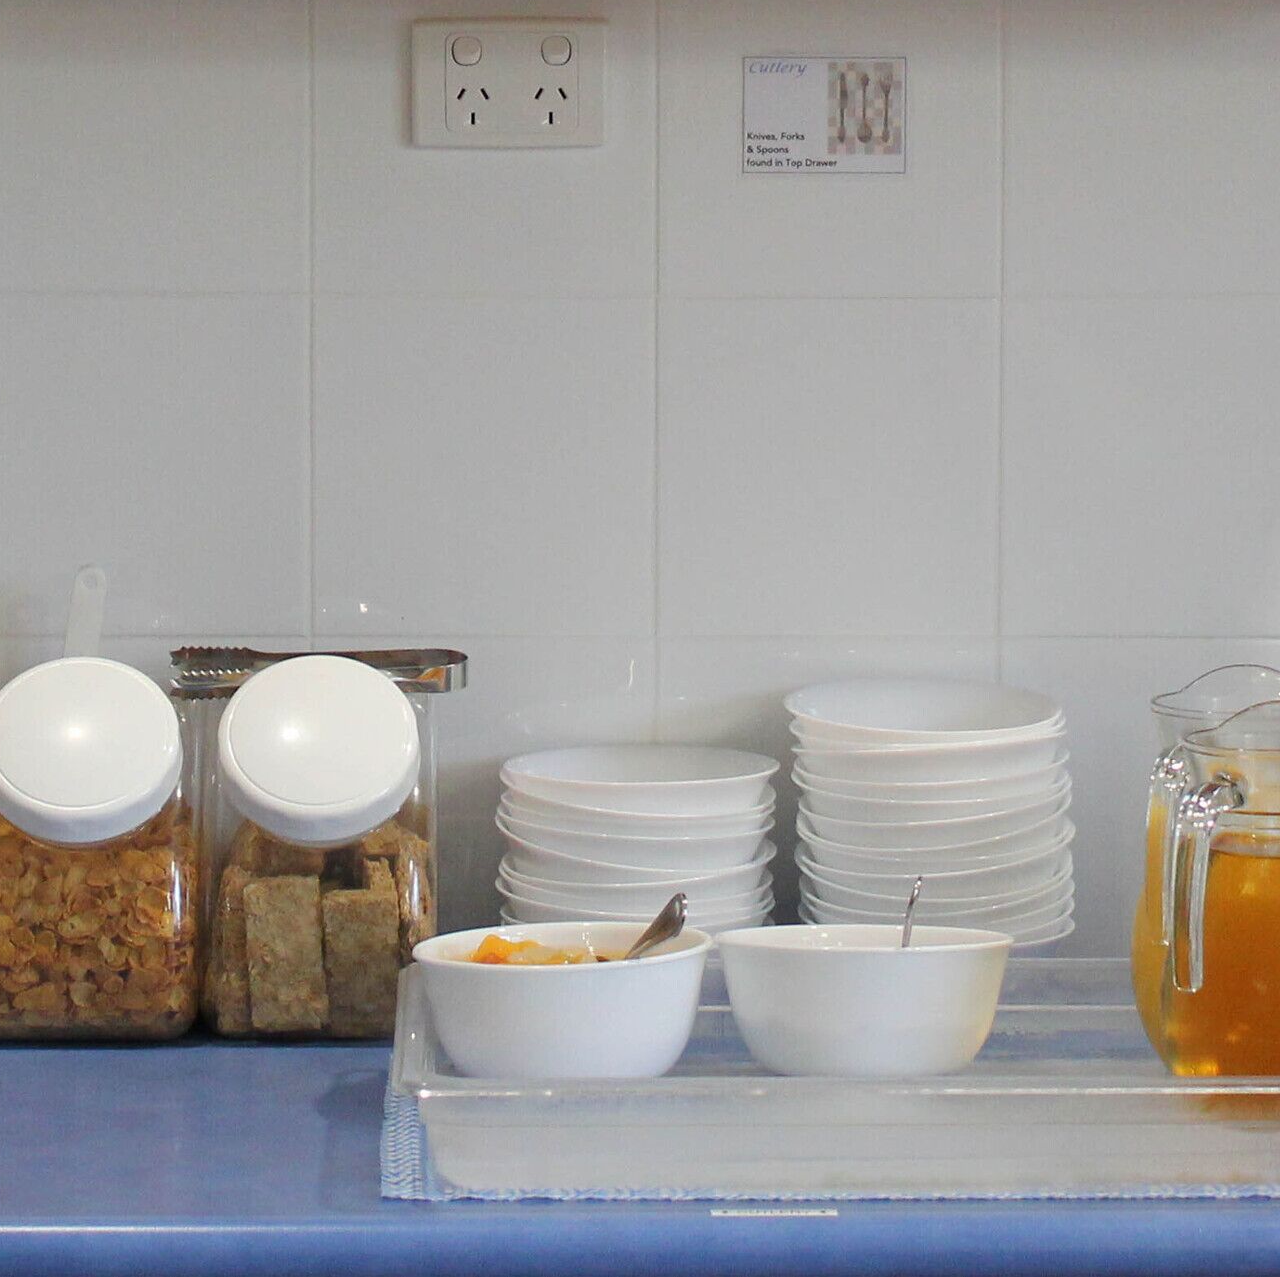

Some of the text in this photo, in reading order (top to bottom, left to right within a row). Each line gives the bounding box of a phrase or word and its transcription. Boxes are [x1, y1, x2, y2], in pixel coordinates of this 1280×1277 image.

[749, 61, 807, 77] Cutlery
[746, 133, 805, 142] Knives, Forks
[756, 146, 789, 156] Spoons
[746, 159, 837, 169] found in Top Drawer
